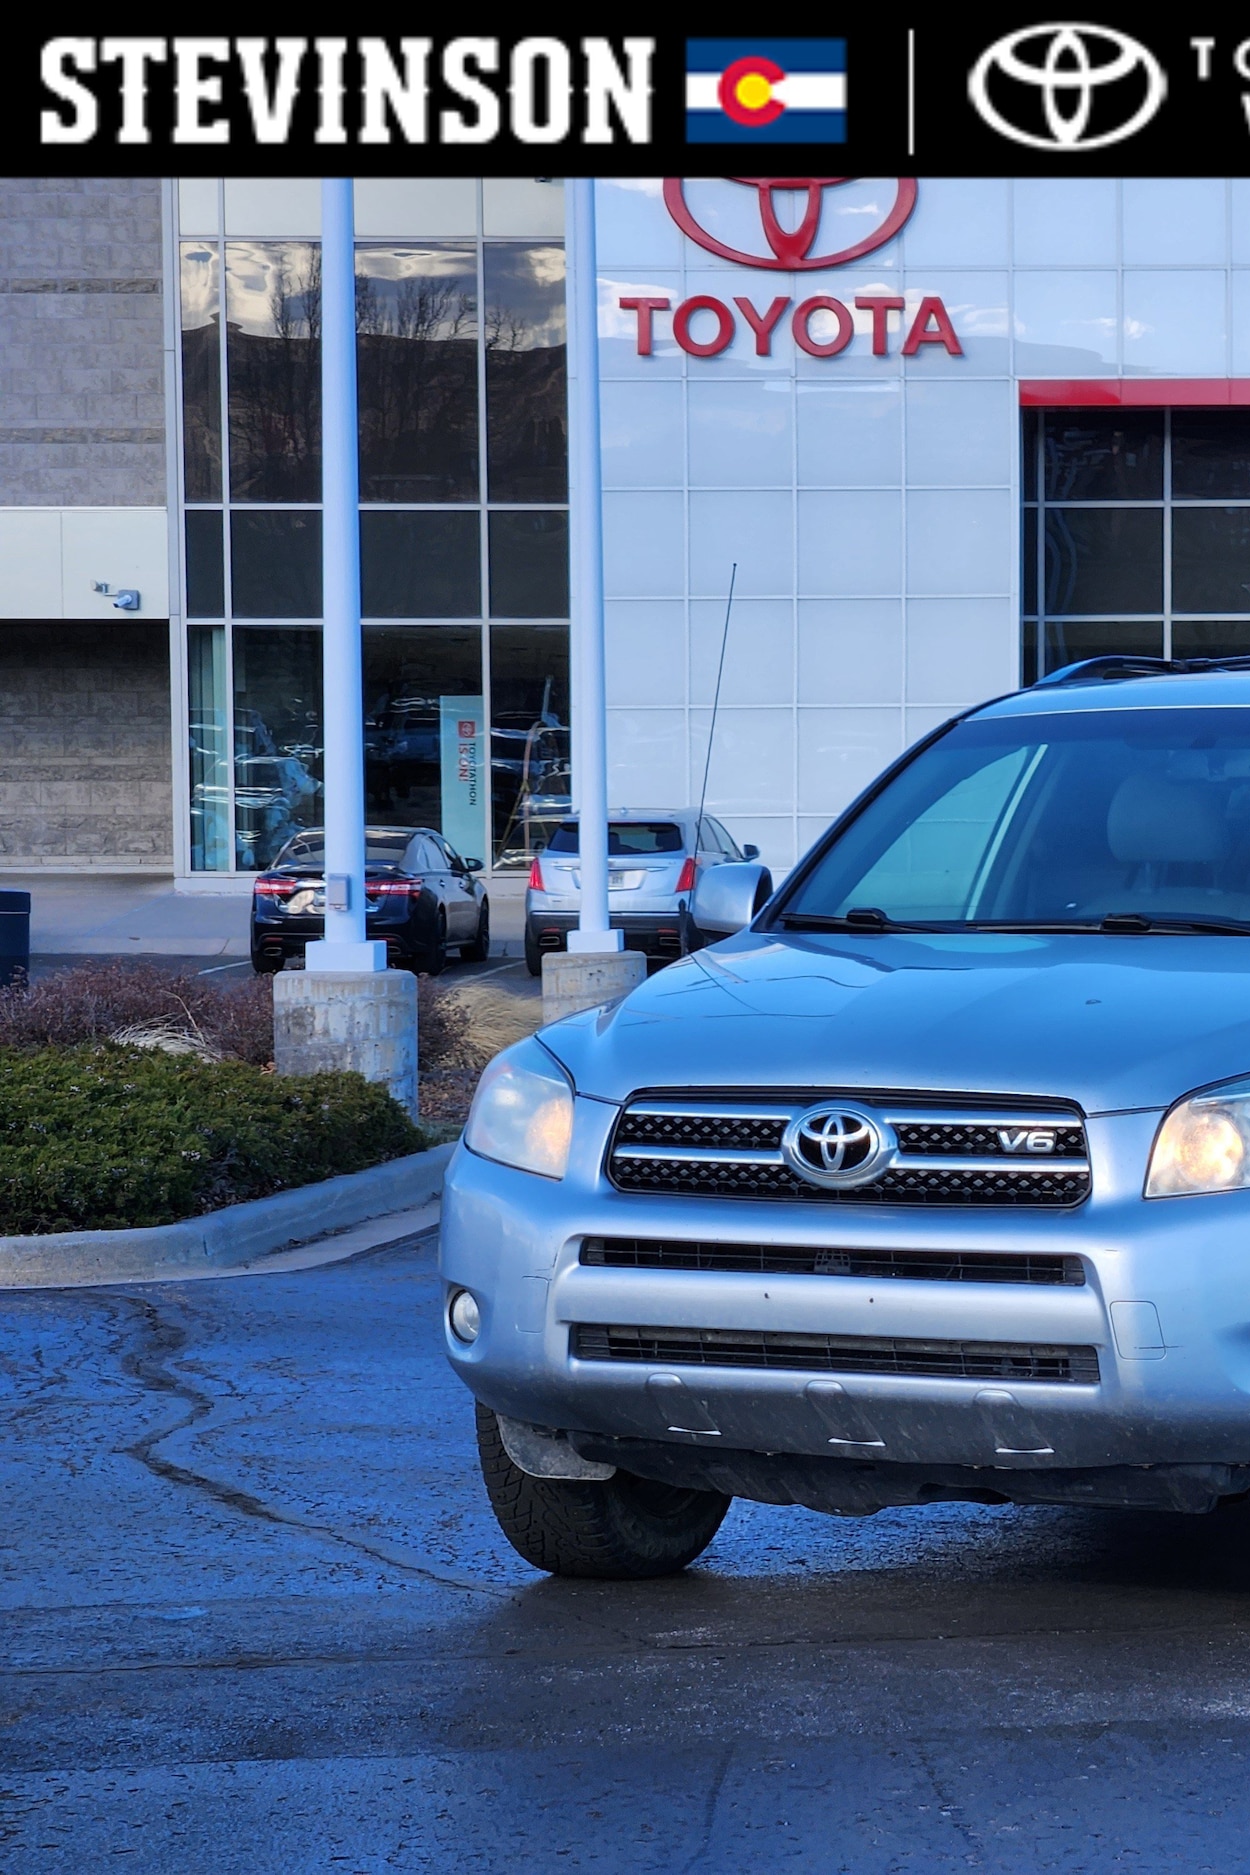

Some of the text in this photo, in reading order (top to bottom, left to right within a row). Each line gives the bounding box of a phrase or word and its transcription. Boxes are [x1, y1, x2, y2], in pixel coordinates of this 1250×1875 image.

[619, 295, 963, 357] TOYOTA
[459, 743, 469, 755] IS
[998, 1130, 1055, 1153] V6
